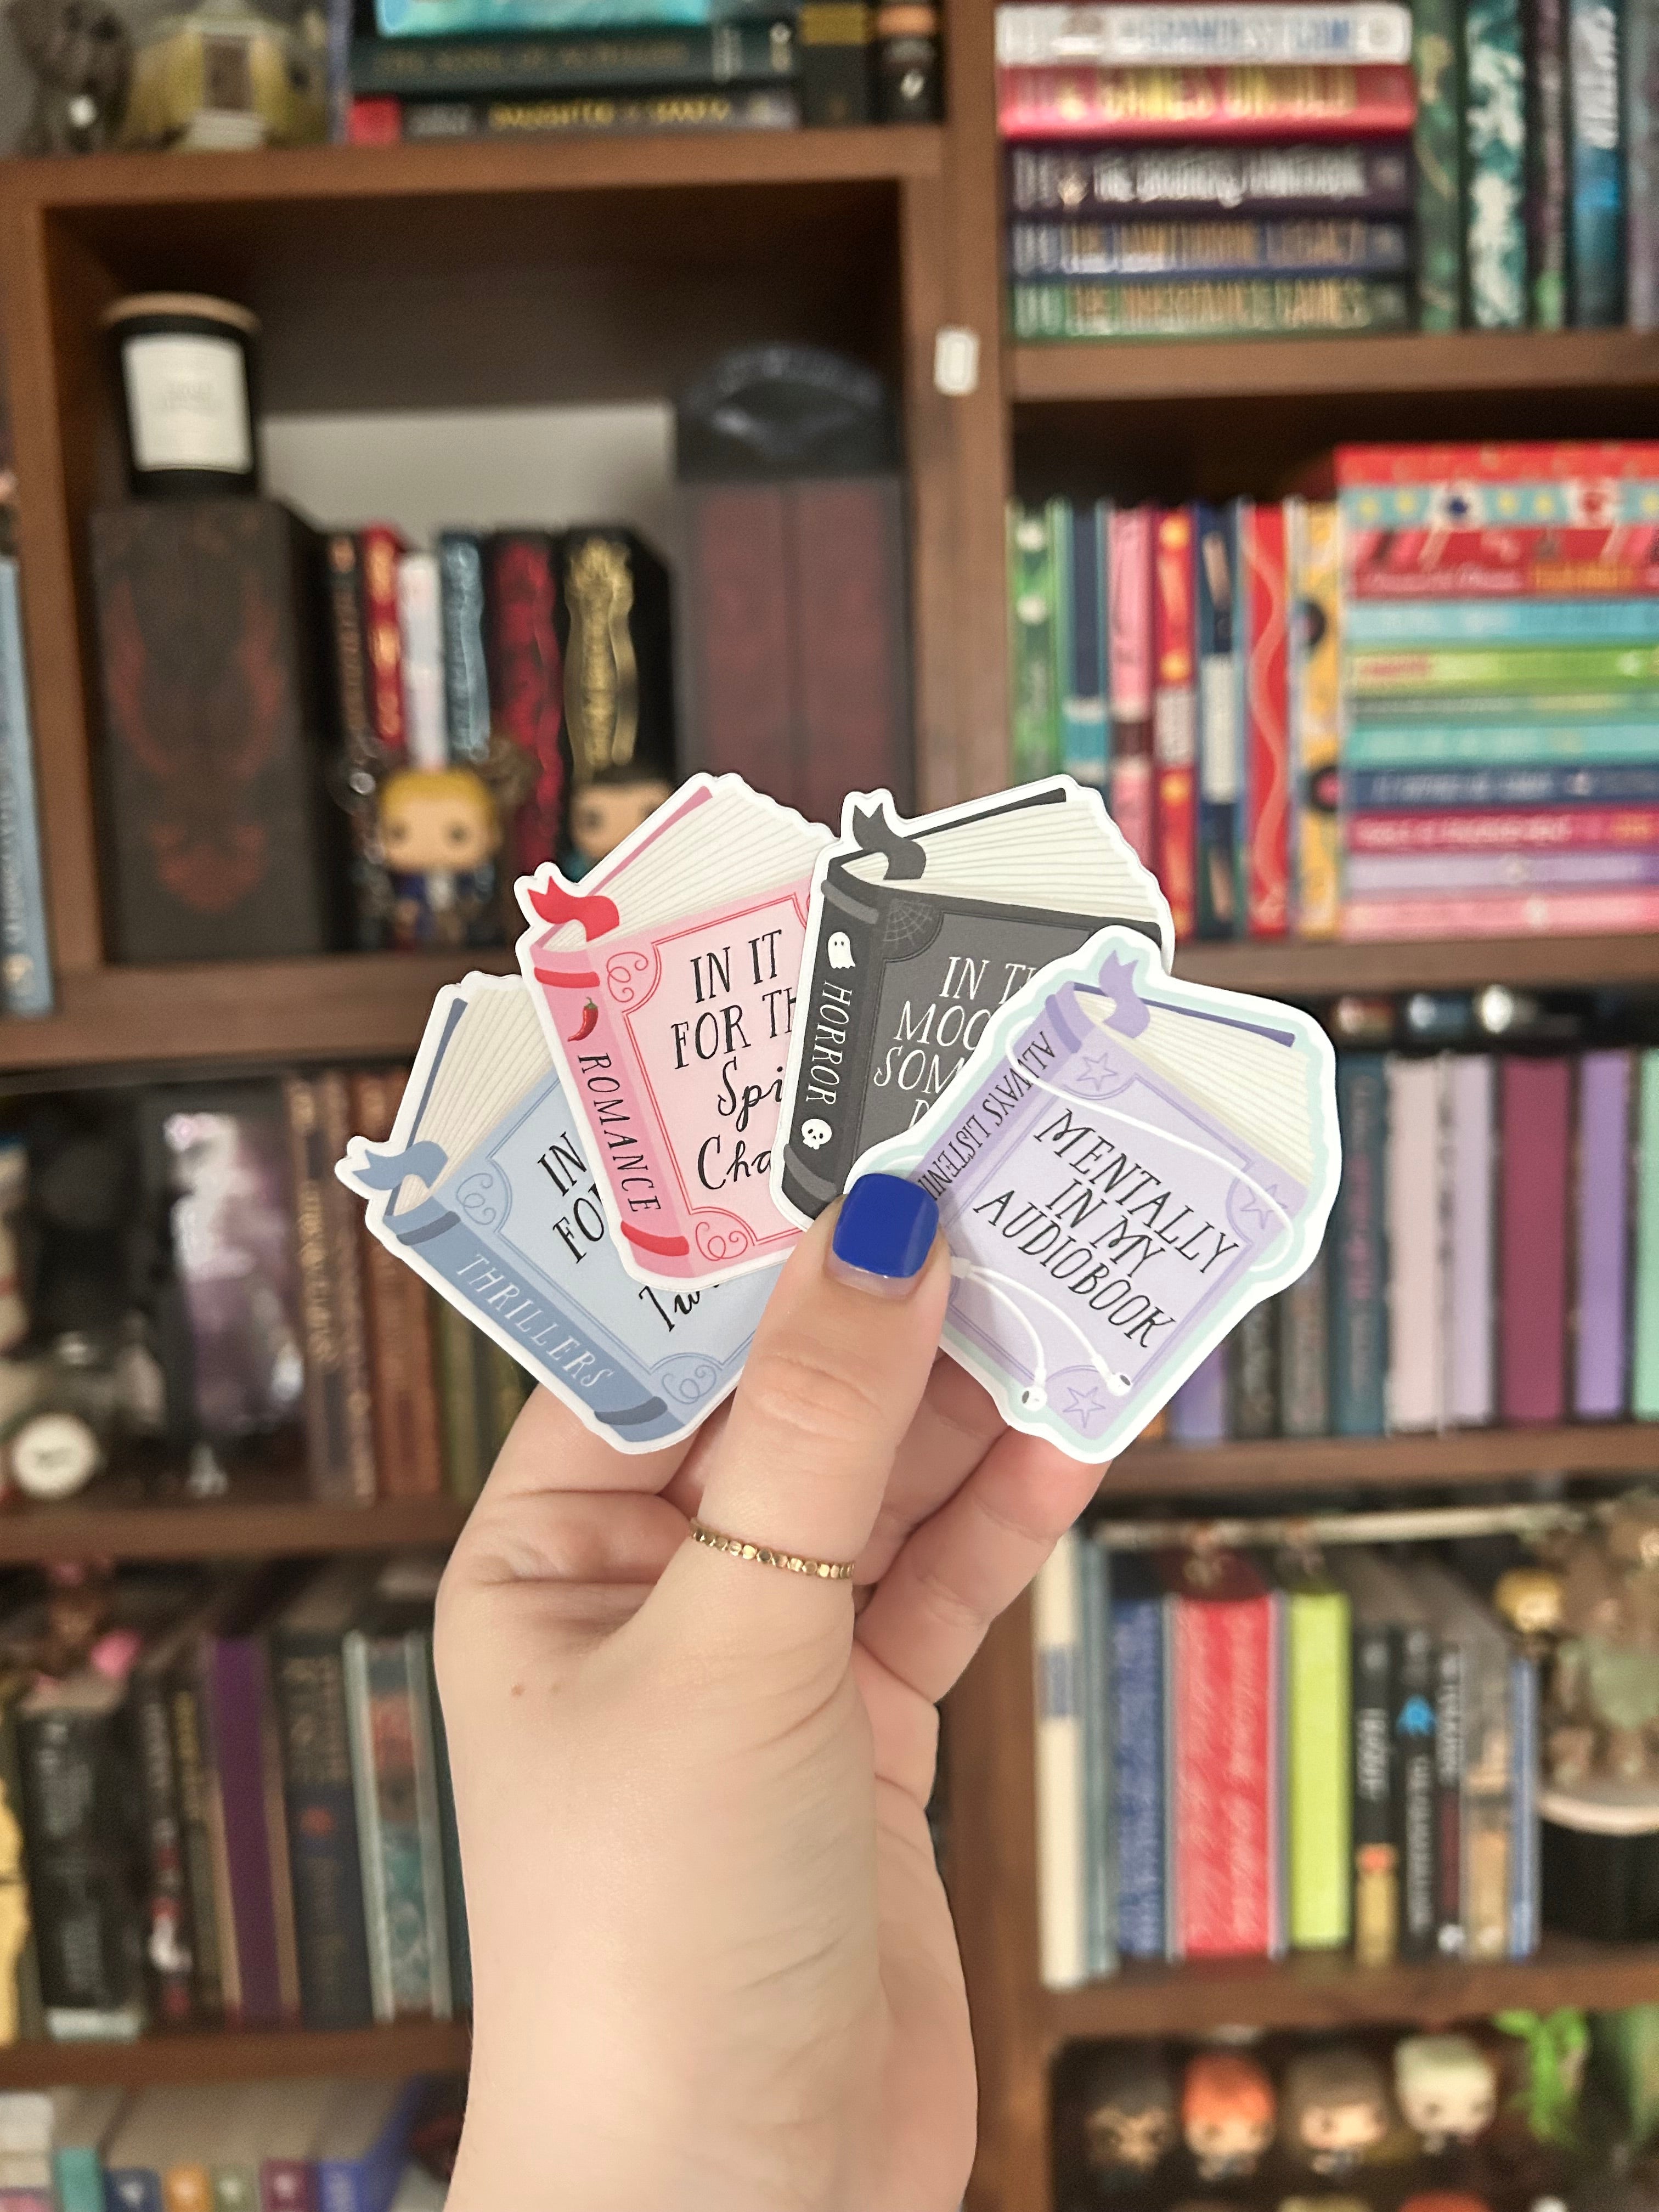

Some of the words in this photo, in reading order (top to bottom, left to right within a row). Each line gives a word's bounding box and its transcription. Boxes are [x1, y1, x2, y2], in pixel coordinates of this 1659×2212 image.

[690, 946, 731, 1003] IN
[749, 929, 782, 985] IT
[939, 957, 991, 1000] IN
[671, 1005, 751, 1069] FOR
[805, 981, 852, 1105] HORROR
[982, 1030, 1057, 1127] ALWAYS
[538, 1131, 587, 1197] IN
[579, 1053, 660, 1211] ROMANCE
[552, 1183, 605, 1264] FO
[1034, 1108, 1240, 1273] MENTALLY
[1046, 1178, 1107, 1228] IN
[1089, 1216, 1165, 1278] MY
[973, 1189, 1177, 1348] AUDIOBOOK
[456, 1254, 614, 1389] THRILLERS
